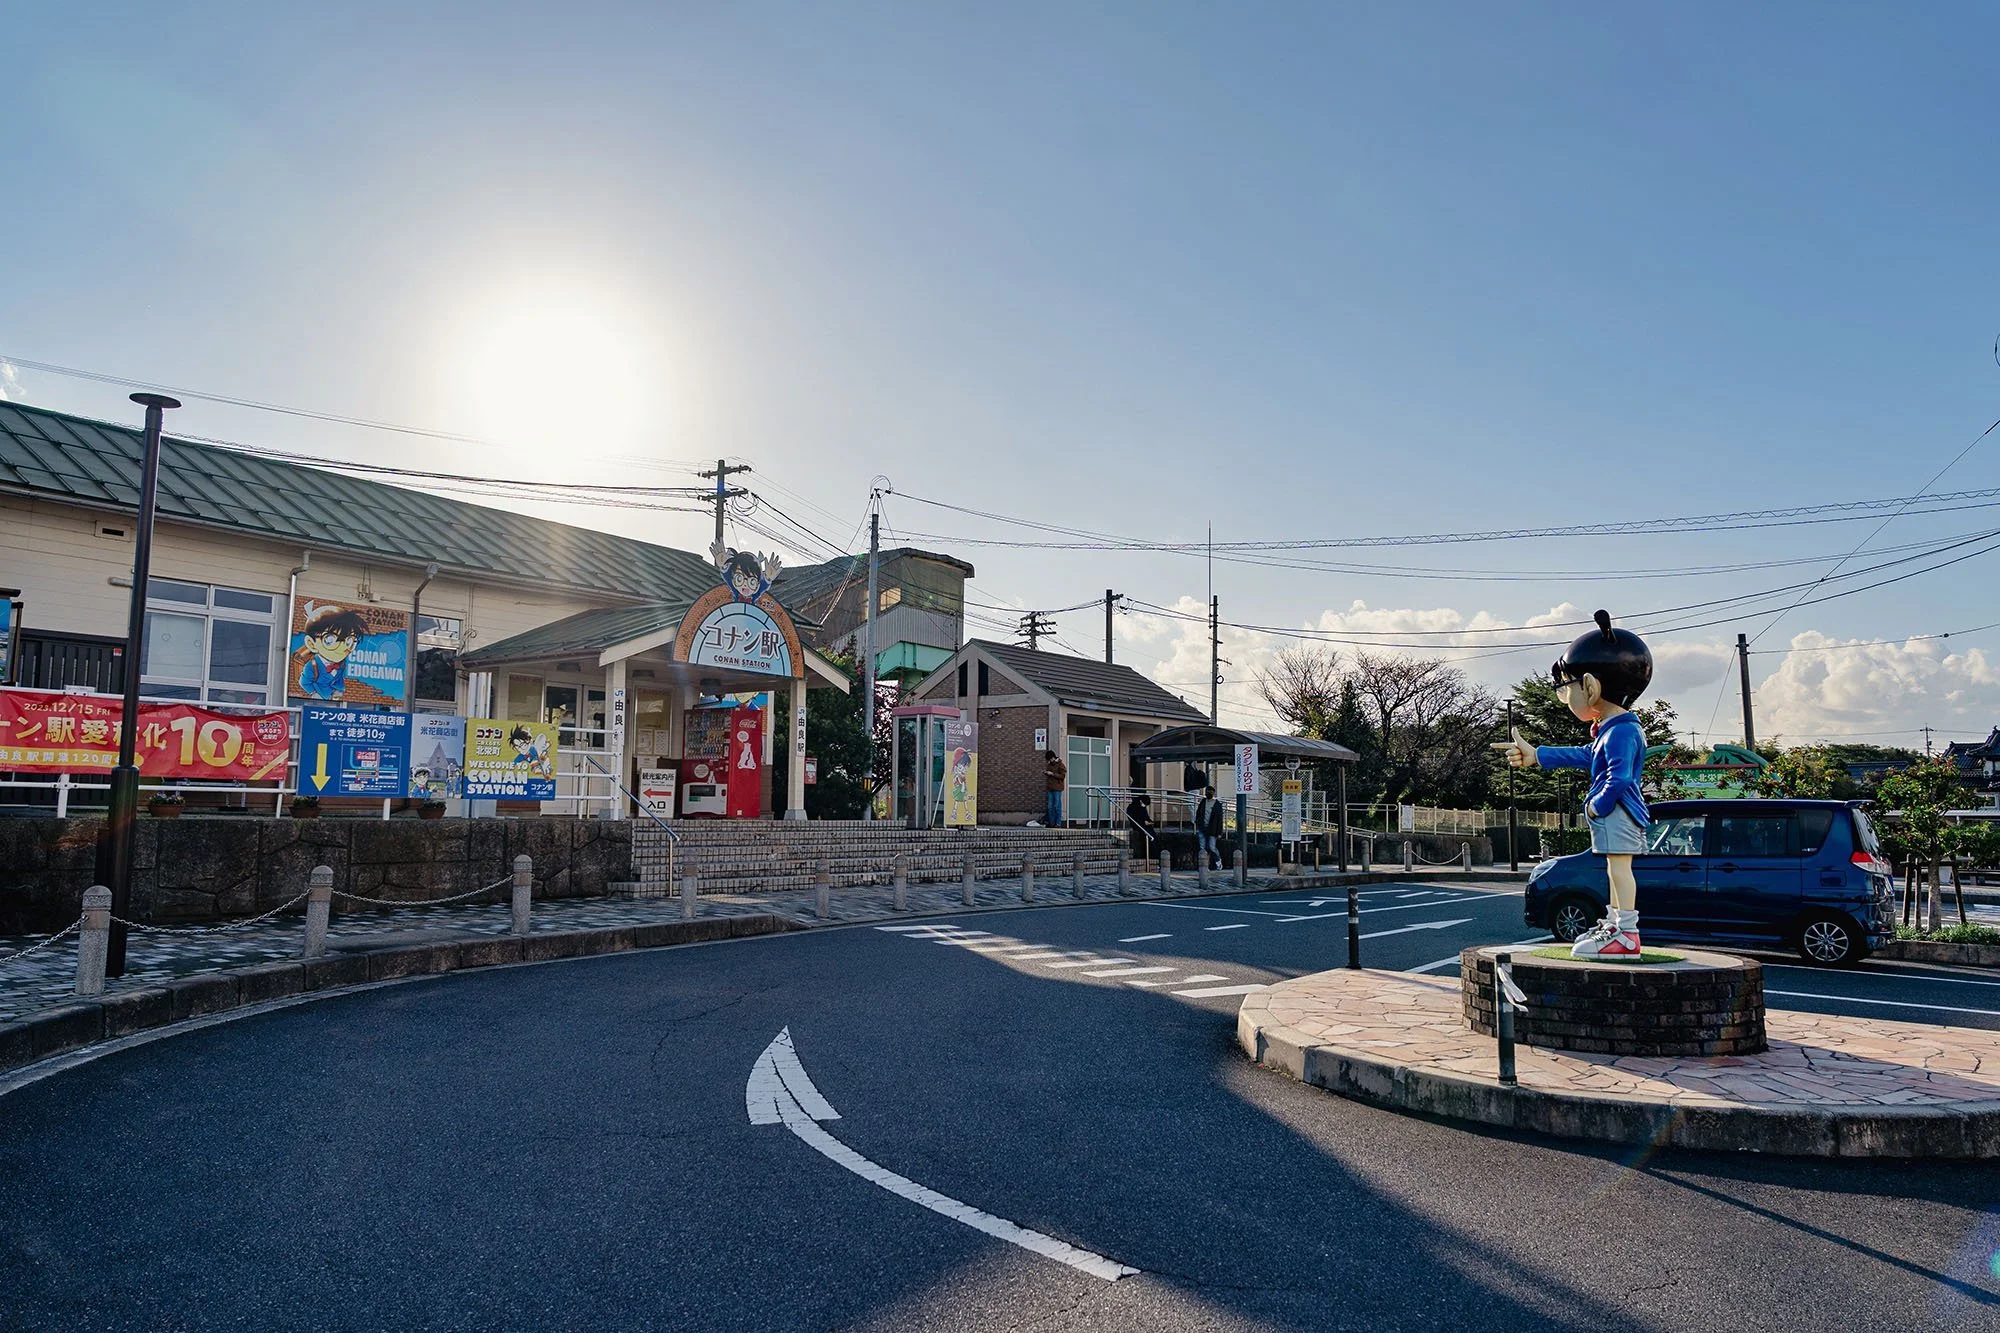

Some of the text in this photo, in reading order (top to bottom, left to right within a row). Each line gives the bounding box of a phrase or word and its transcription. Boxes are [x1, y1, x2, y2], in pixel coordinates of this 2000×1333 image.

[366, 608, 404, 619] CONAN
[366, 617, 404, 628] STATION
[704, 624, 781, 660] コナン駅
[348, 649, 387, 665] CONAN
[713, 654, 771, 669] CONAN STATION
[347, 663, 403, 681] EDOGAWA
[96, 708, 111, 716] FRI
[310, 710, 406, 726] コナンの家 米花商店街
[329, 729, 344, 737] まで
[346, 728, 386, 740] 徒歩10分
[475, 727, 504, 740] コナン
[170, 716, 242, 767] 10
[241, 742, 255, 768] 周年
[469, 760, 529, 770] WELCOME TO
[1242, 746, 1253, 792] タクシーのりば
[468, 769, 528, 785] CONAN
[467, 783, 528, 796] STATION.
[530, 783, 554, 792] コナン駅
[647, 800, 666, 809] 入口
